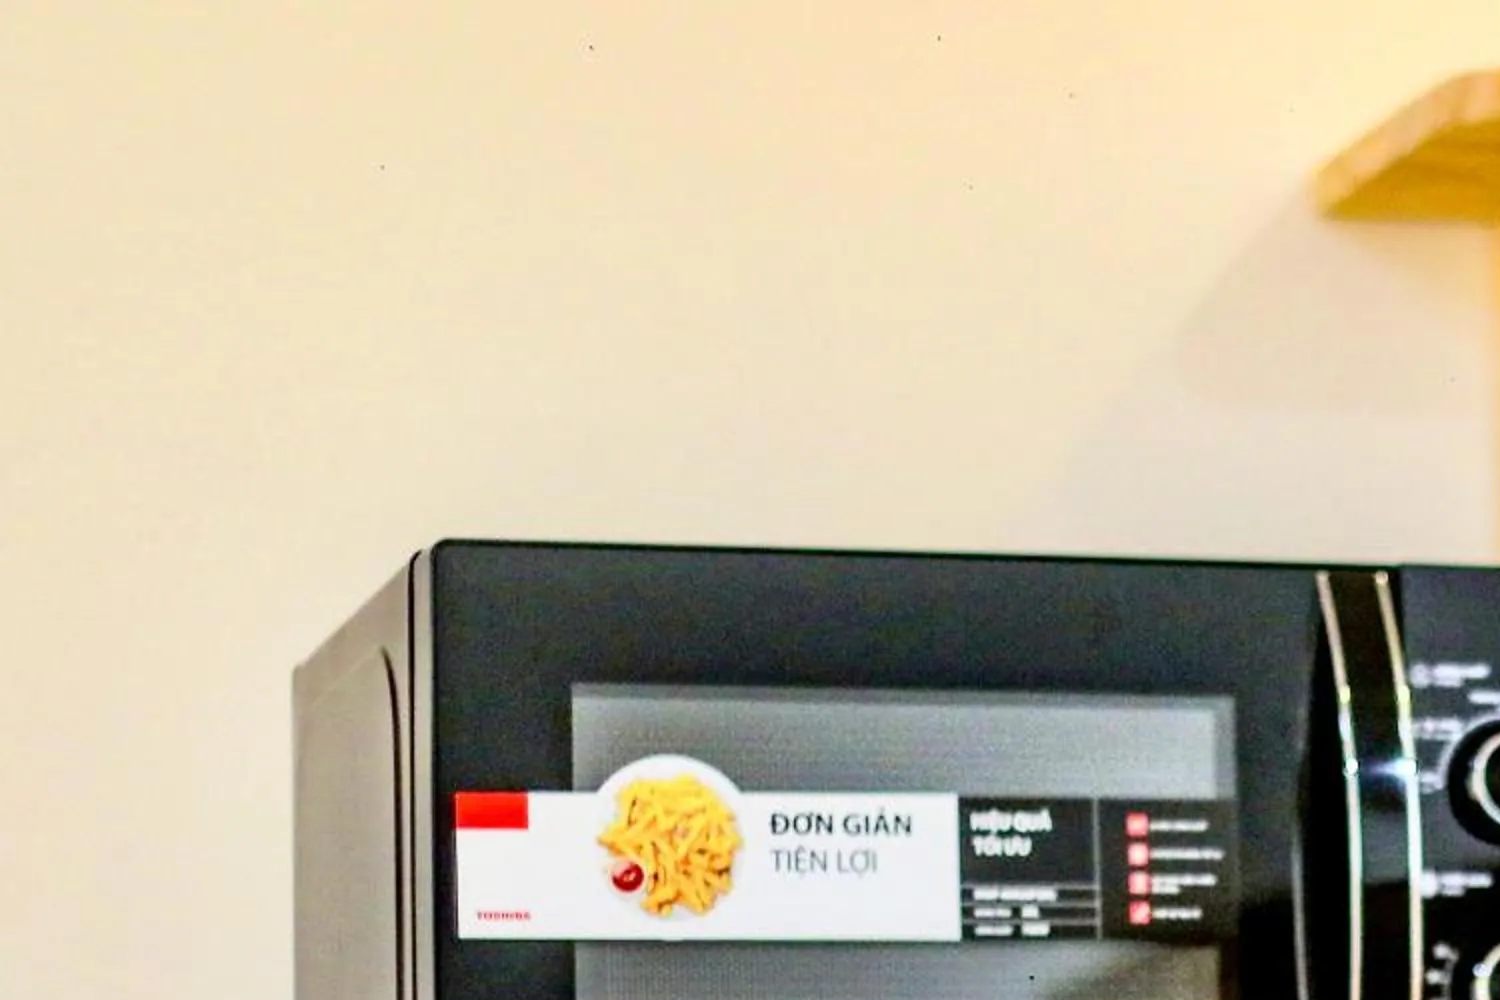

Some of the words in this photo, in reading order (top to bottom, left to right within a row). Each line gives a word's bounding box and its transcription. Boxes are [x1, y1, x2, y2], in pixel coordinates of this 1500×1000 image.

[770, 812, 833, 836] ĐƠN
[842, 806, 912, 837] GIẢN
[771, 845, 828, 880] TIỆN
[836, 848, 878, 880] LỢI
[476, 911, 531, 921] TOSHIBA
